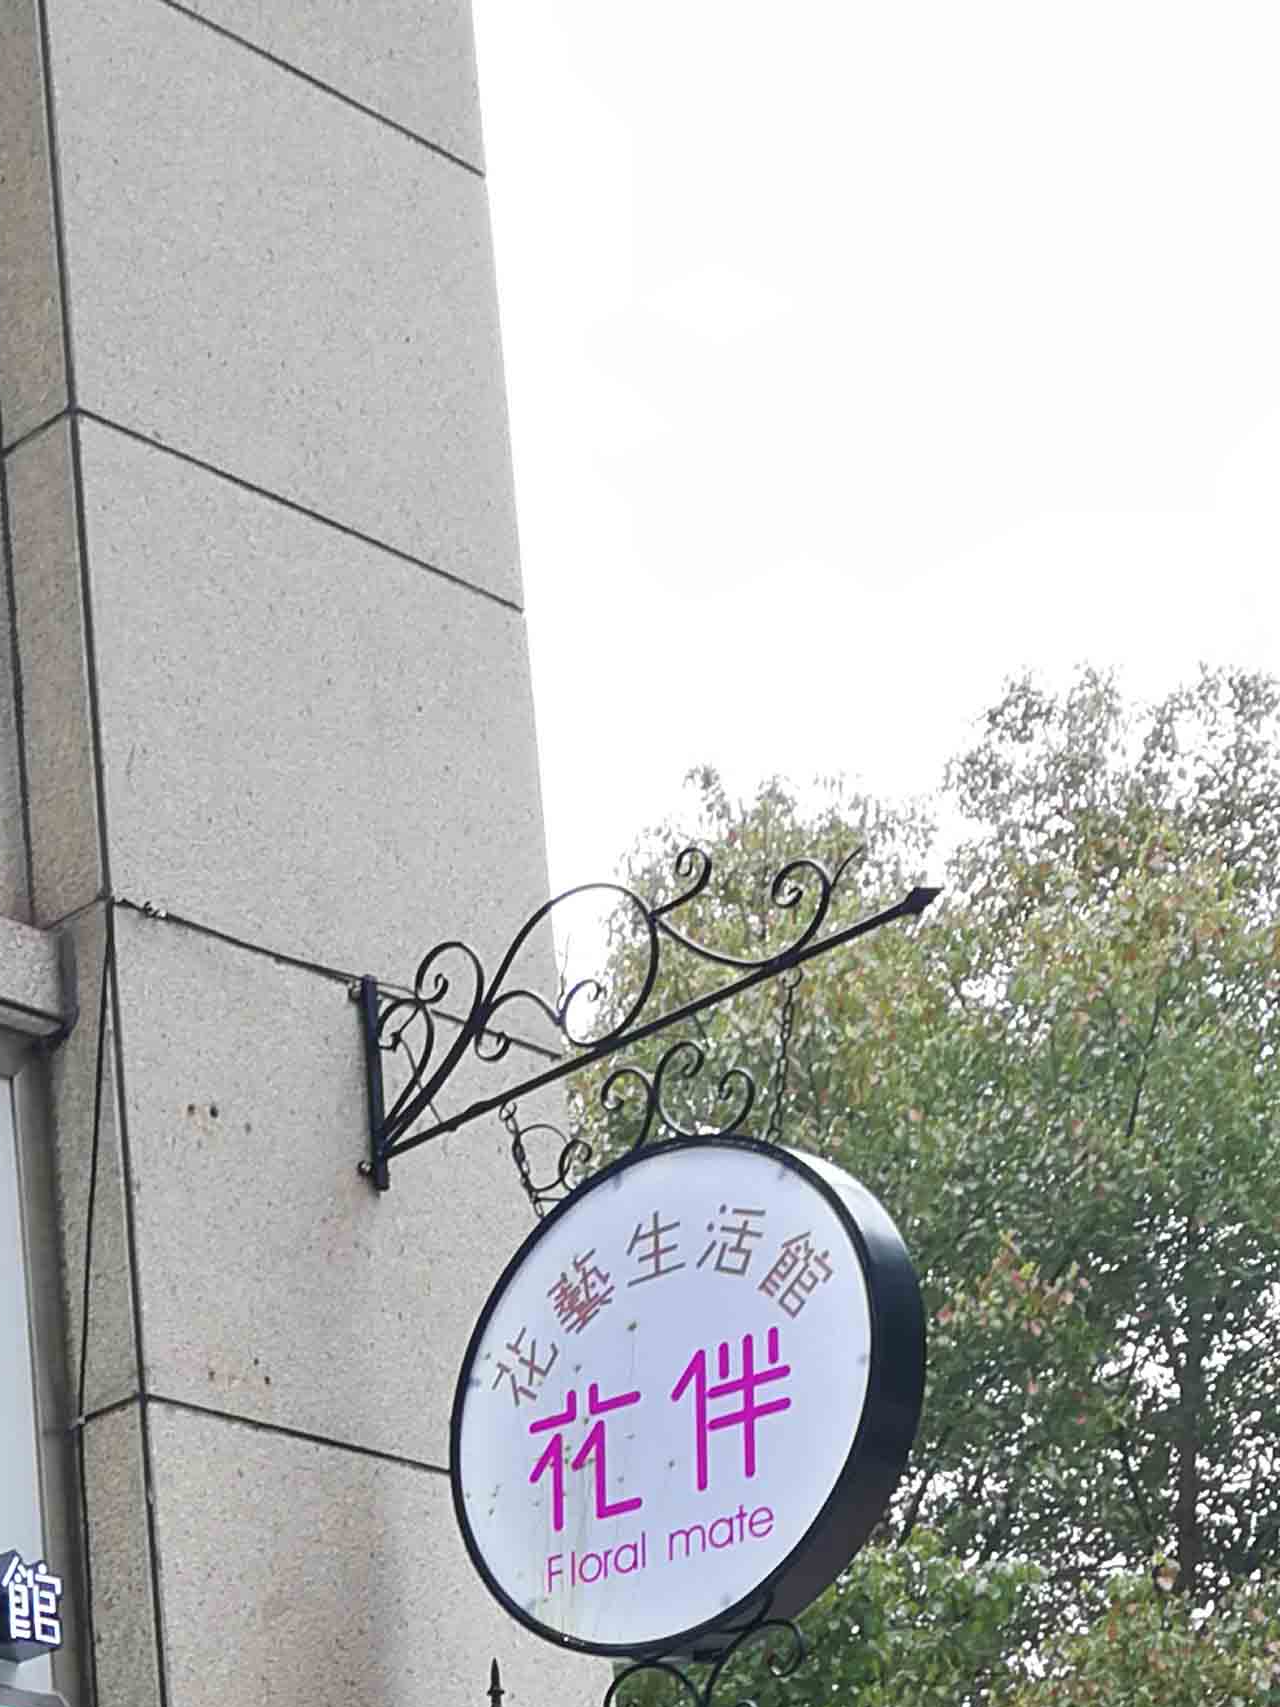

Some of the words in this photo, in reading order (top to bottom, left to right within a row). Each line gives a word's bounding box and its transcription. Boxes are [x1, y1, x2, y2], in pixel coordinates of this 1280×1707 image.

[528, 1326, 793, 1532] 花伴
[546, 1532, 647, 1594] Floral
[667, 1504, 776, 1562] mate
